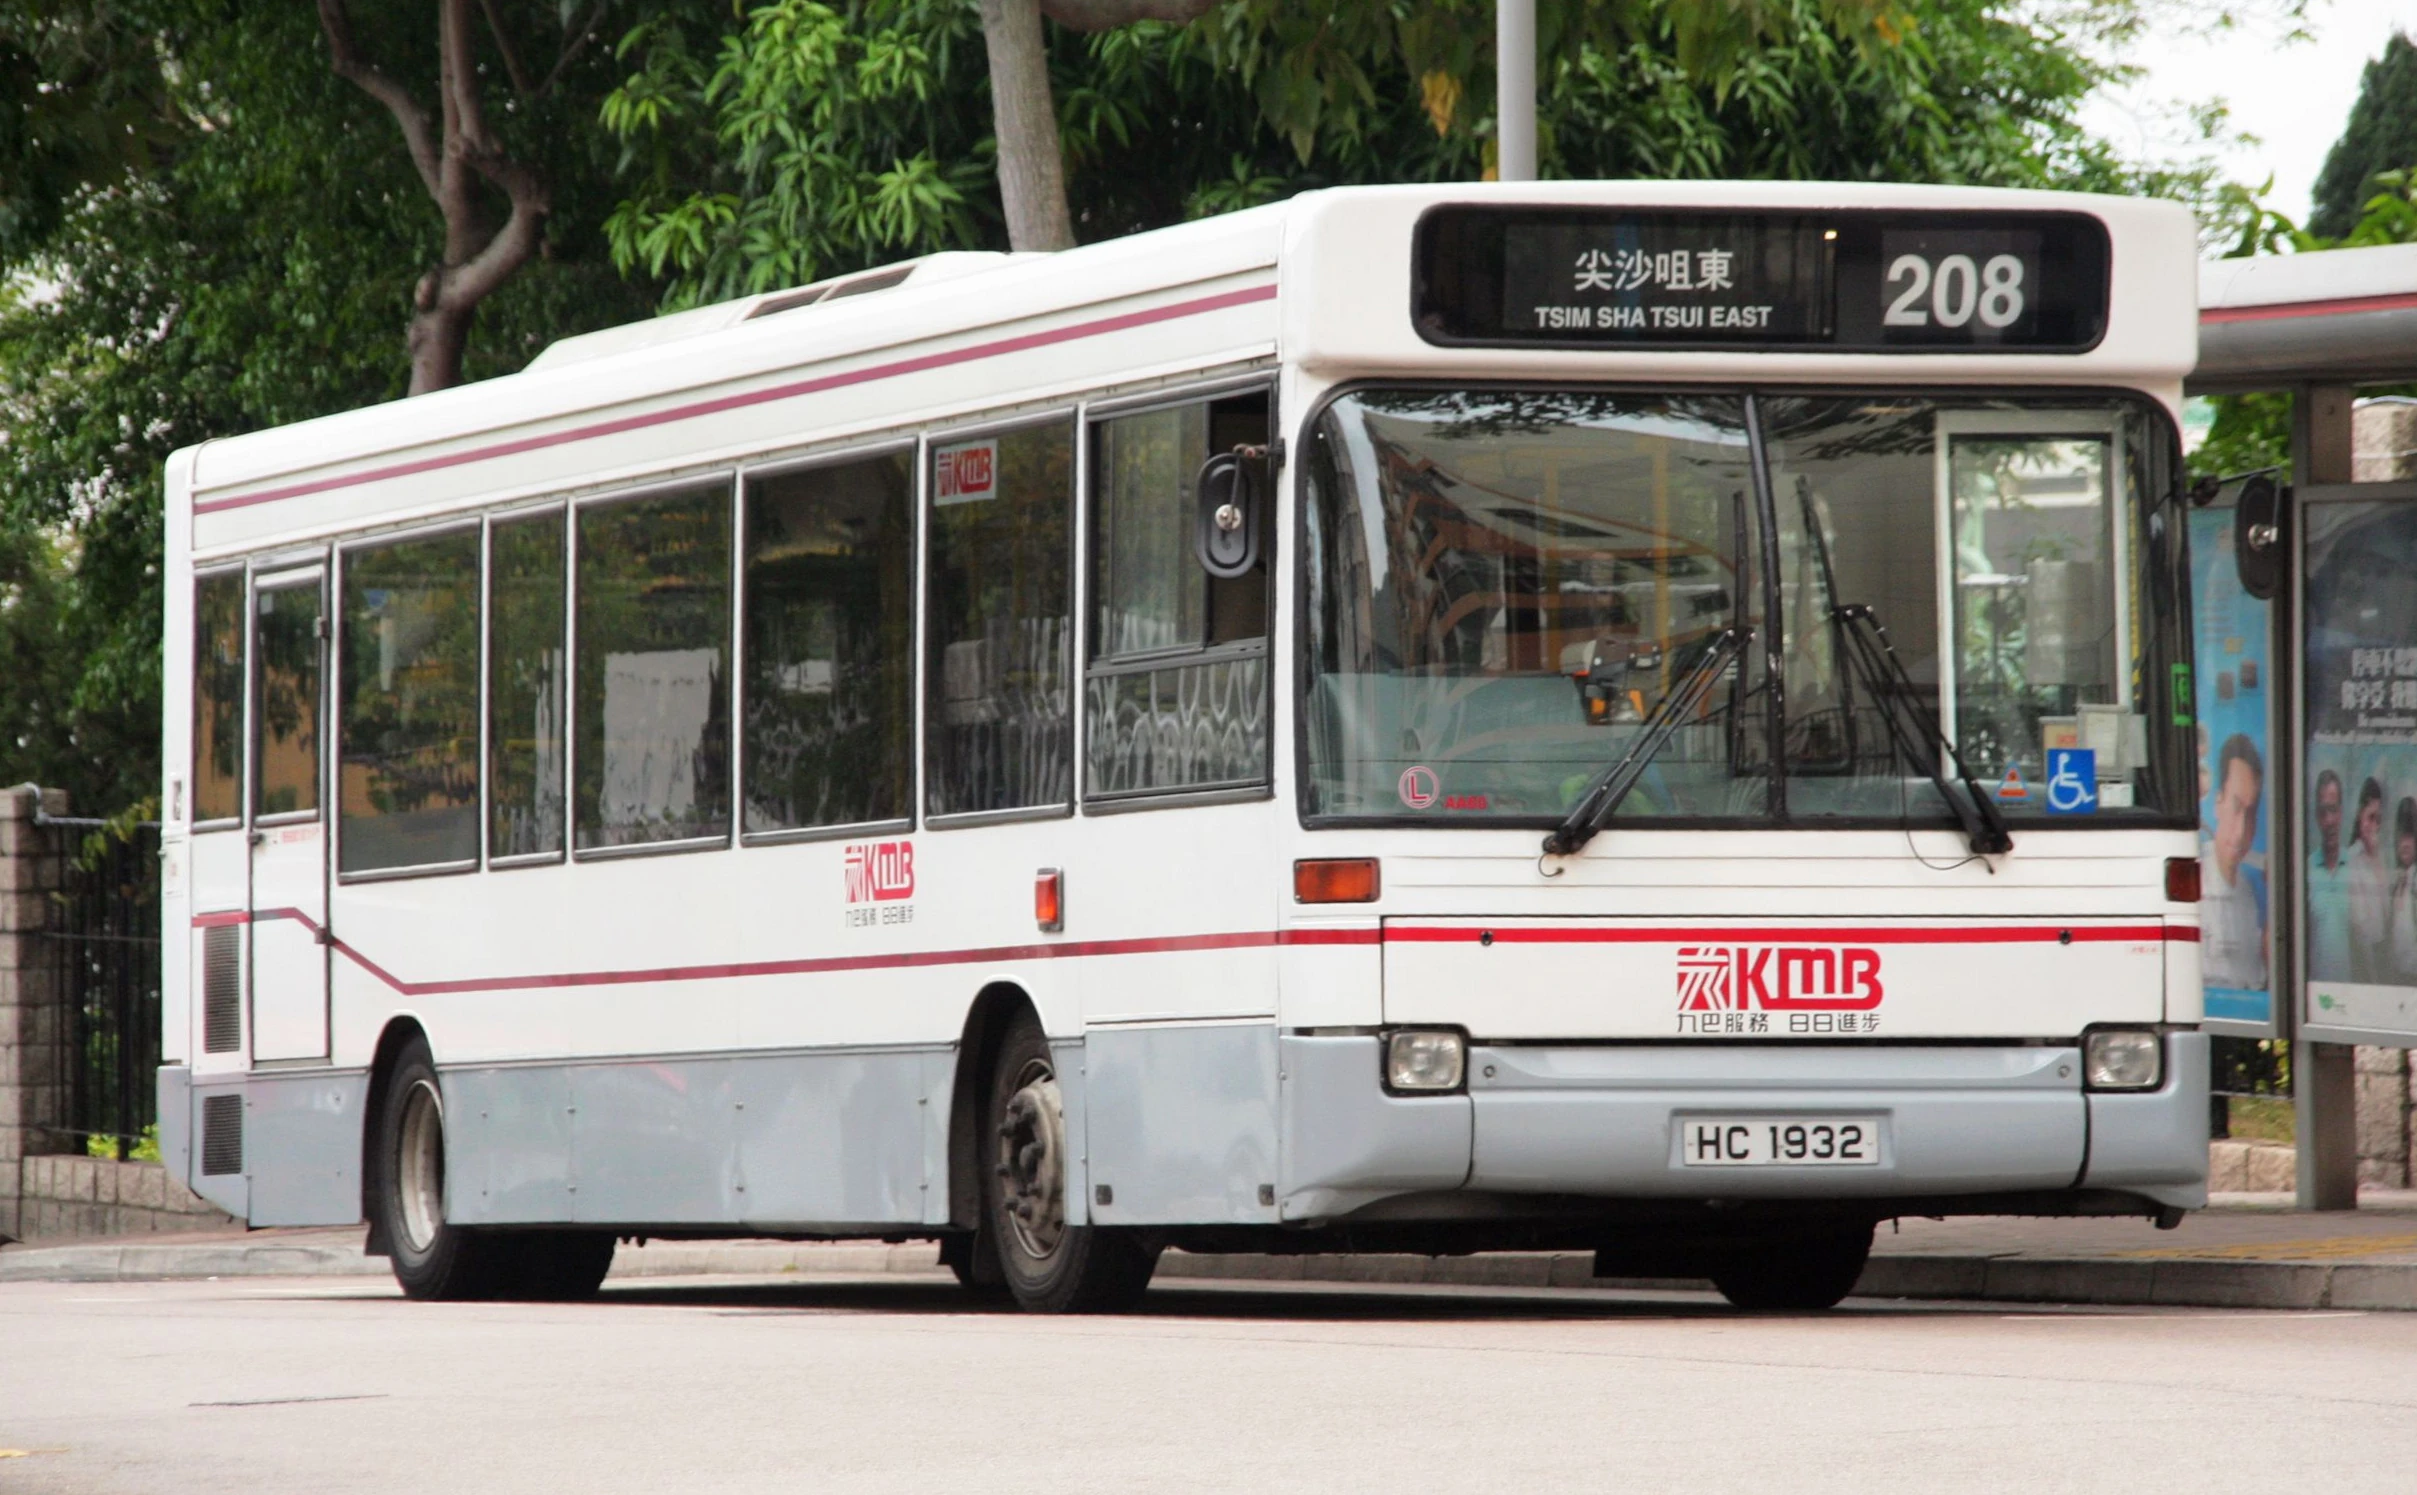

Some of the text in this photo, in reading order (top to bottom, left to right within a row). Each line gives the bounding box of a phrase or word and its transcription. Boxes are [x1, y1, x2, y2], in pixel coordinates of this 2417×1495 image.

[1574, 248, 1735, 292] 尖沙咀東
[1884, 254, 2025, 328] 208
[1534, 306, 1773, 328] TSIM SHA TSUI EAST
[864, 841, 914, 902] KMB
[1736, 948, 1883, 1010] KMB
[1677, 1013, 1880, 1033] 九巴服務 日日進步
[1697, 1125, 1863, 1159] HC 1932
